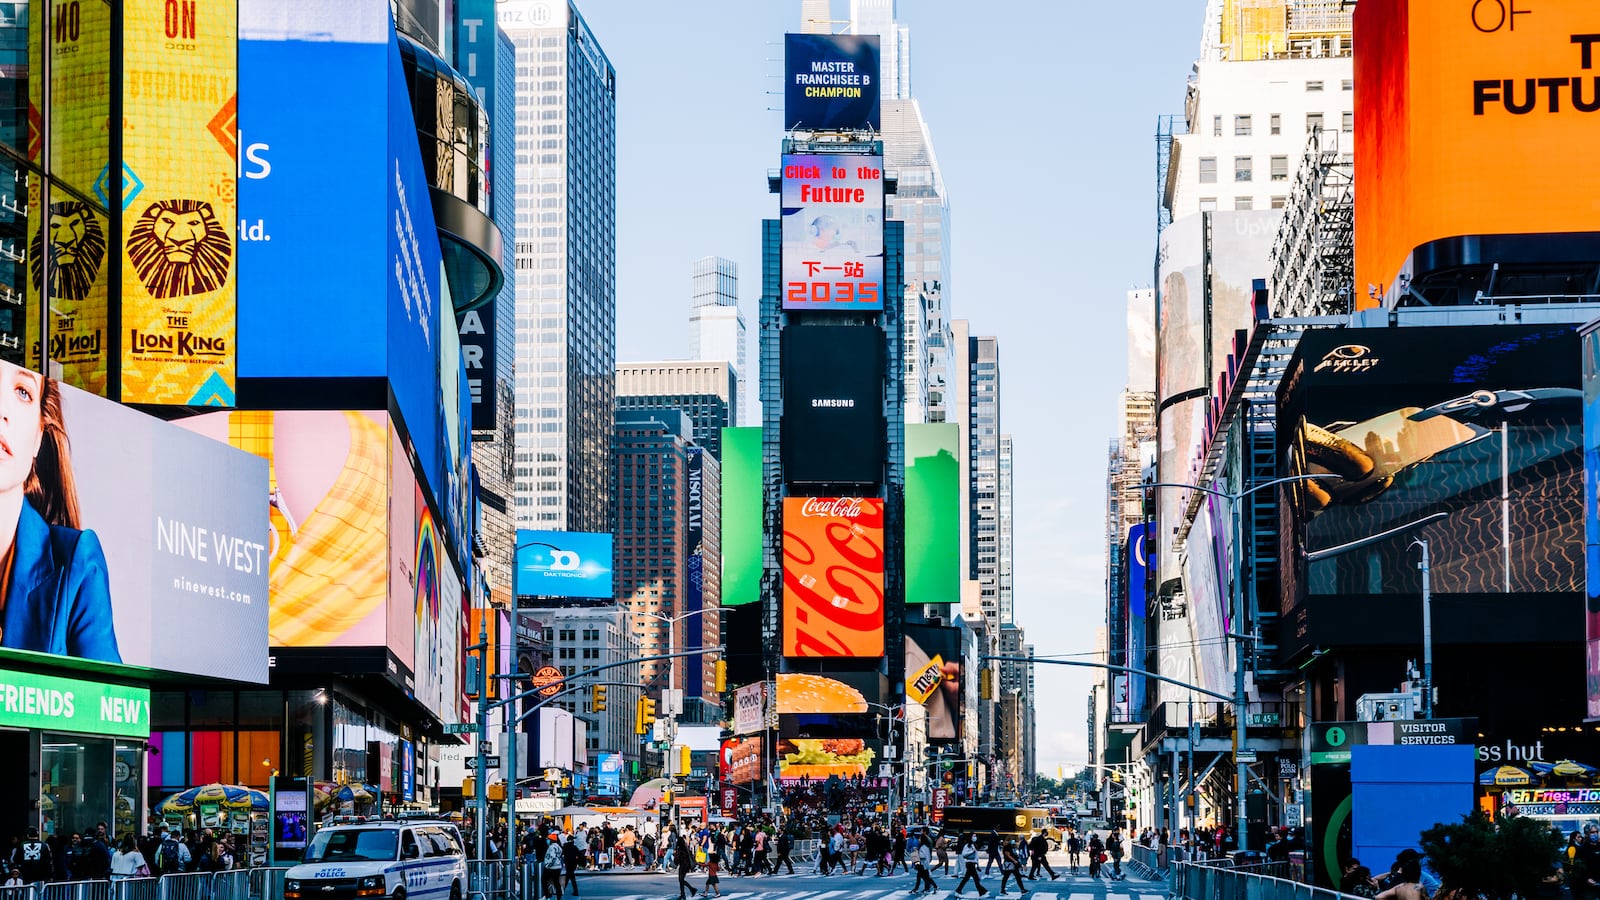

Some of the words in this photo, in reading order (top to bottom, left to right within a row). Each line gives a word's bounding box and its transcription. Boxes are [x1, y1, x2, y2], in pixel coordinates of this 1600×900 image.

[165, 0, 196, 40] ON
[1472, 0, 1532, 32] OF
[812, 62, 854, 73] MASTER
[796, 74, 860, 85] FRANCHISEE
[863, 75, 870, 86] B
[805, 86, 861, 98] CHAMPION
[1474, 76, 1600, 116] FUTU
[785, 166, 820, 179] Click
[832, 166, 846, 179] to
[857, 166, 880, 180] the
[801, 184, 864, 203] Future
[238, 219, 270, 241] ld.
[802, 261, 864, 278] 下一站
[788, 282, 878, 302] 2035
[166, 316, 188, 326] THE
[132, 329, 173, 354] LION
[178, 332, 225, 356] KING
[812, 398, 854, 408] SAMSUNG
[802, 496, 864, 518] Coca-Cola
[156, 516, 207, 562] NINE
[213, 534, 265, 576] WEST
[174, 576, 251, 604] ninewest.com
[100, 696, 141, 724] NEW
[1254, 715, 1260, 724] W
[1262, 714, 1272, 723] 45
[461, 724, 469, 732] 45
[1400, 724, 1446, 733] VISITOR
[1401, 735, 1455, 745] SERVICES
[1507, 739, 1544, 761] hut
[724, 790, 734, 809] tkts
[936, 789, 946, 809] tkts
